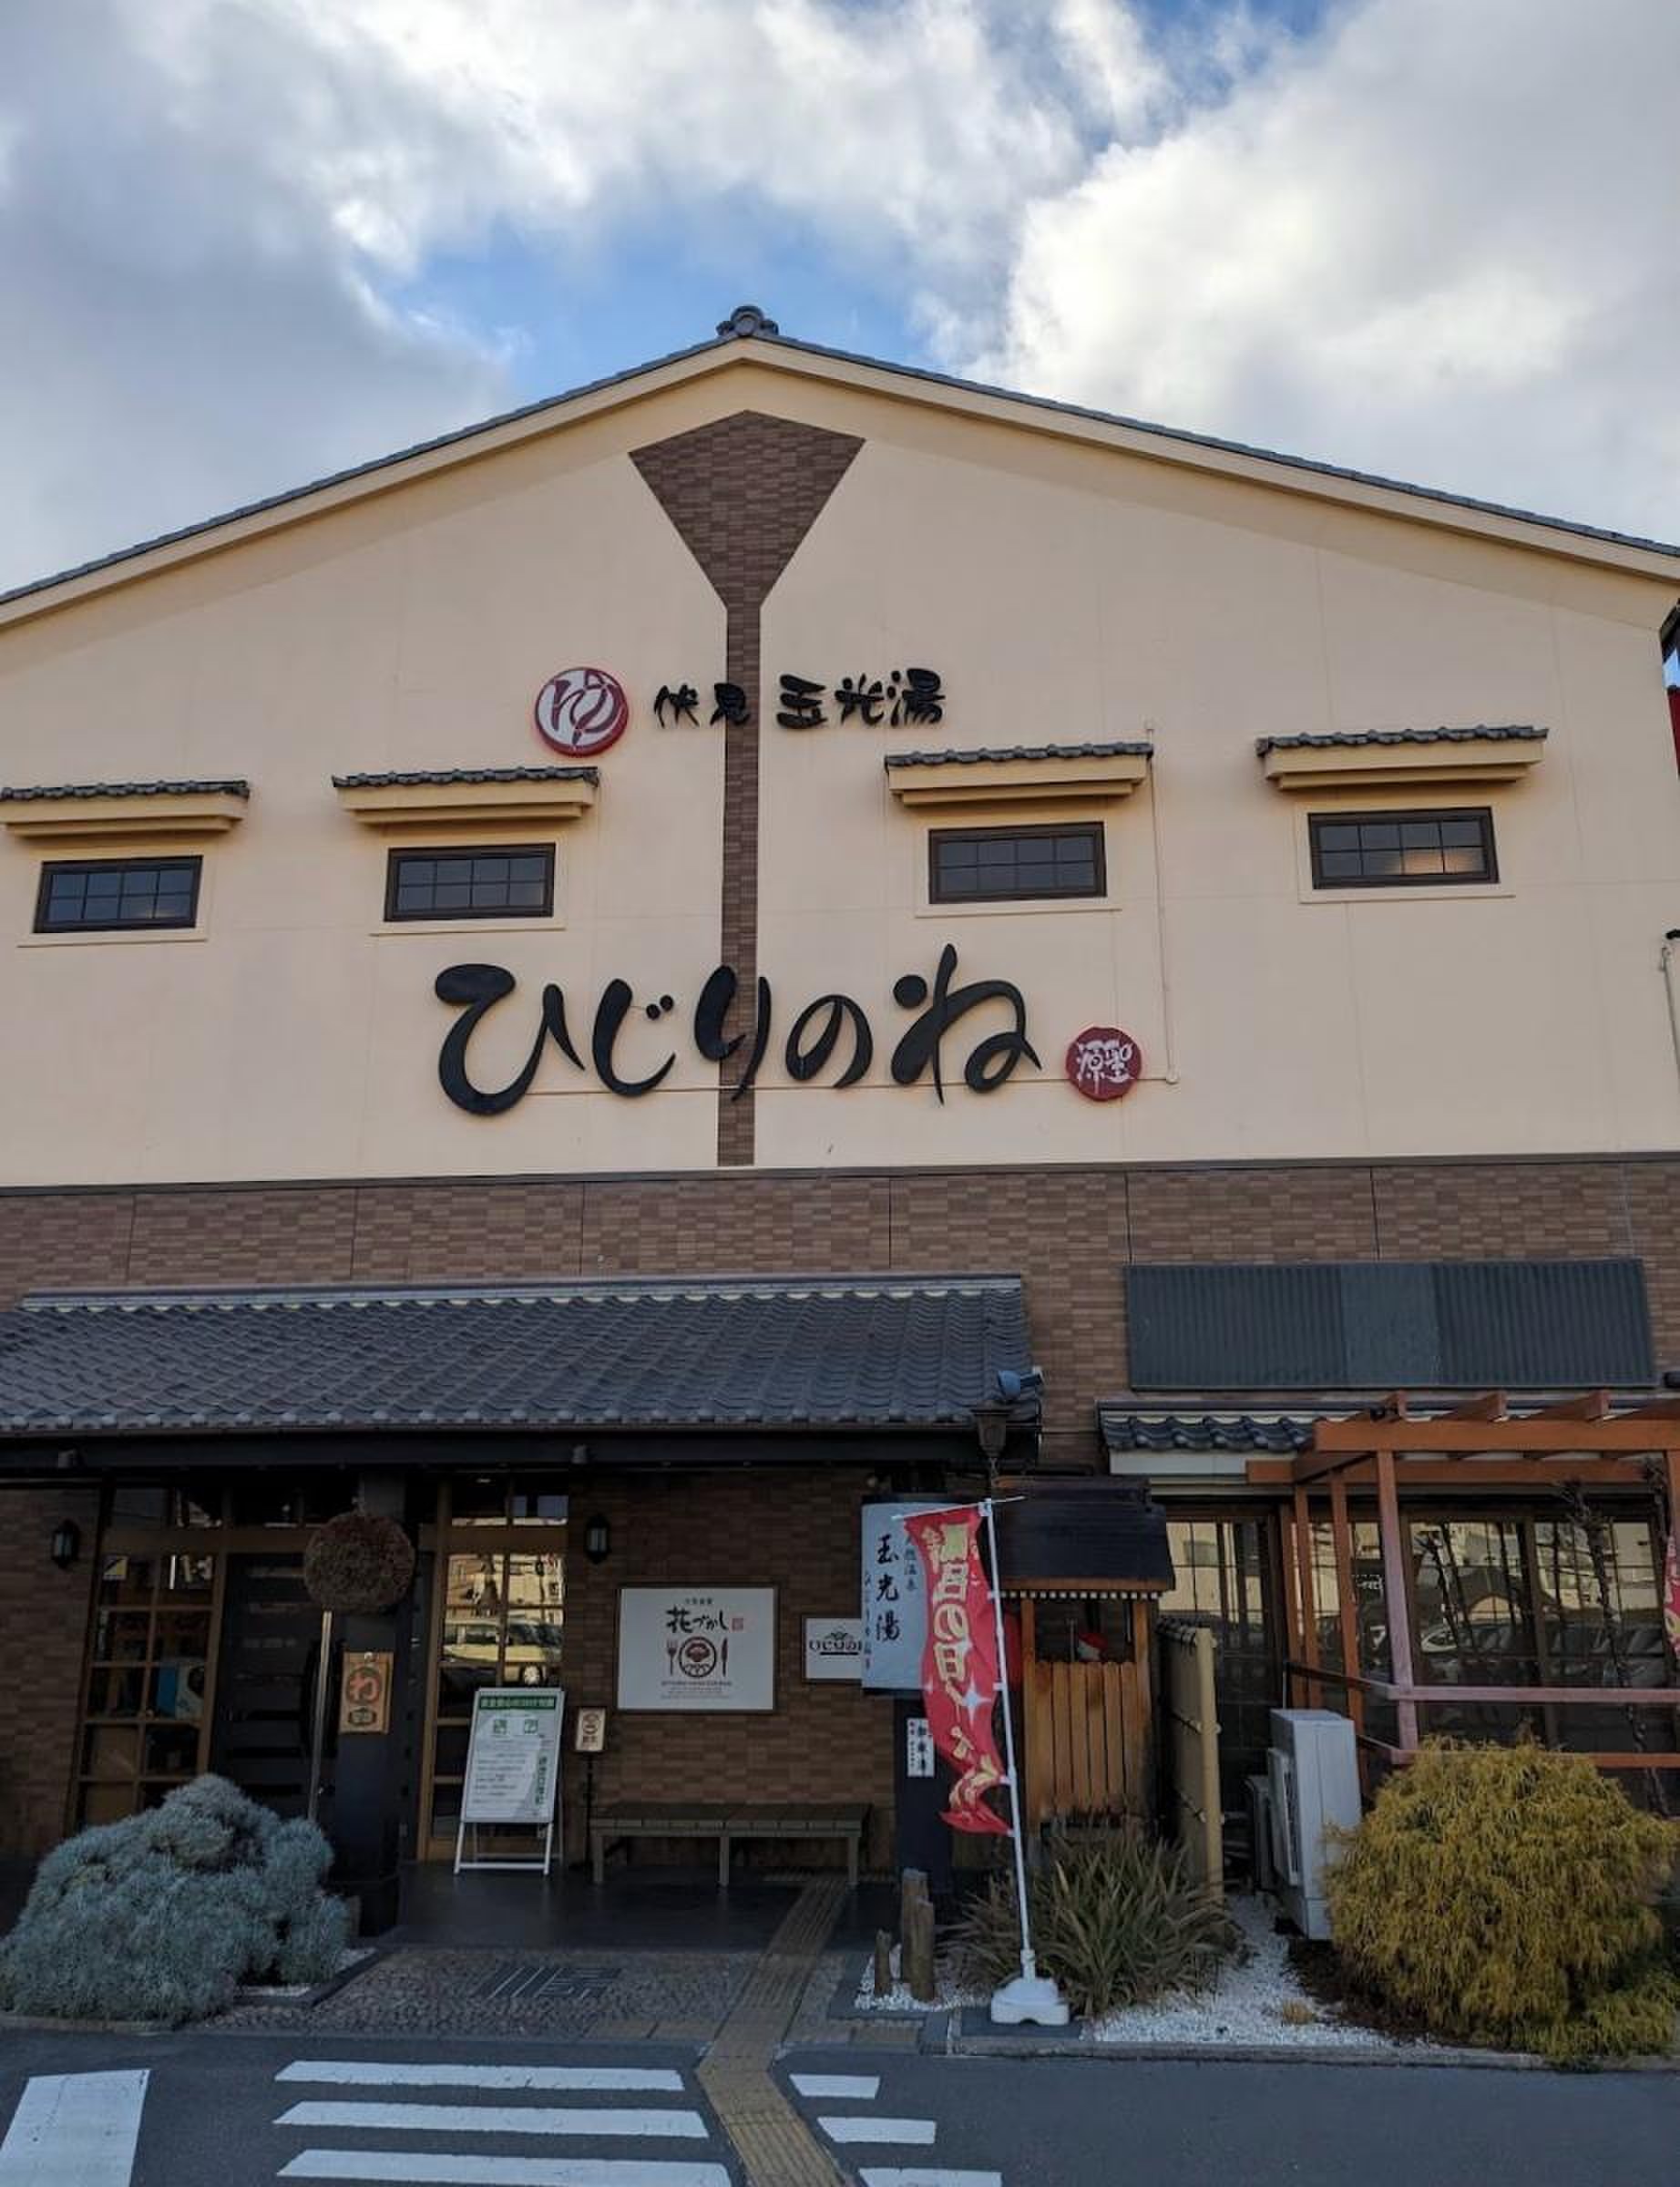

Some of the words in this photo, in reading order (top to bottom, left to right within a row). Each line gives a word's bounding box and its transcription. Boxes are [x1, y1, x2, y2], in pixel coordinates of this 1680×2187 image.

[654, 683, 751, 728] 伏見
[776, 668, 945, 730] 玉光湯
[435, 944, 1042, 1117] ひじりのね
[876, 1534, 900, 1642] 玉光湯
